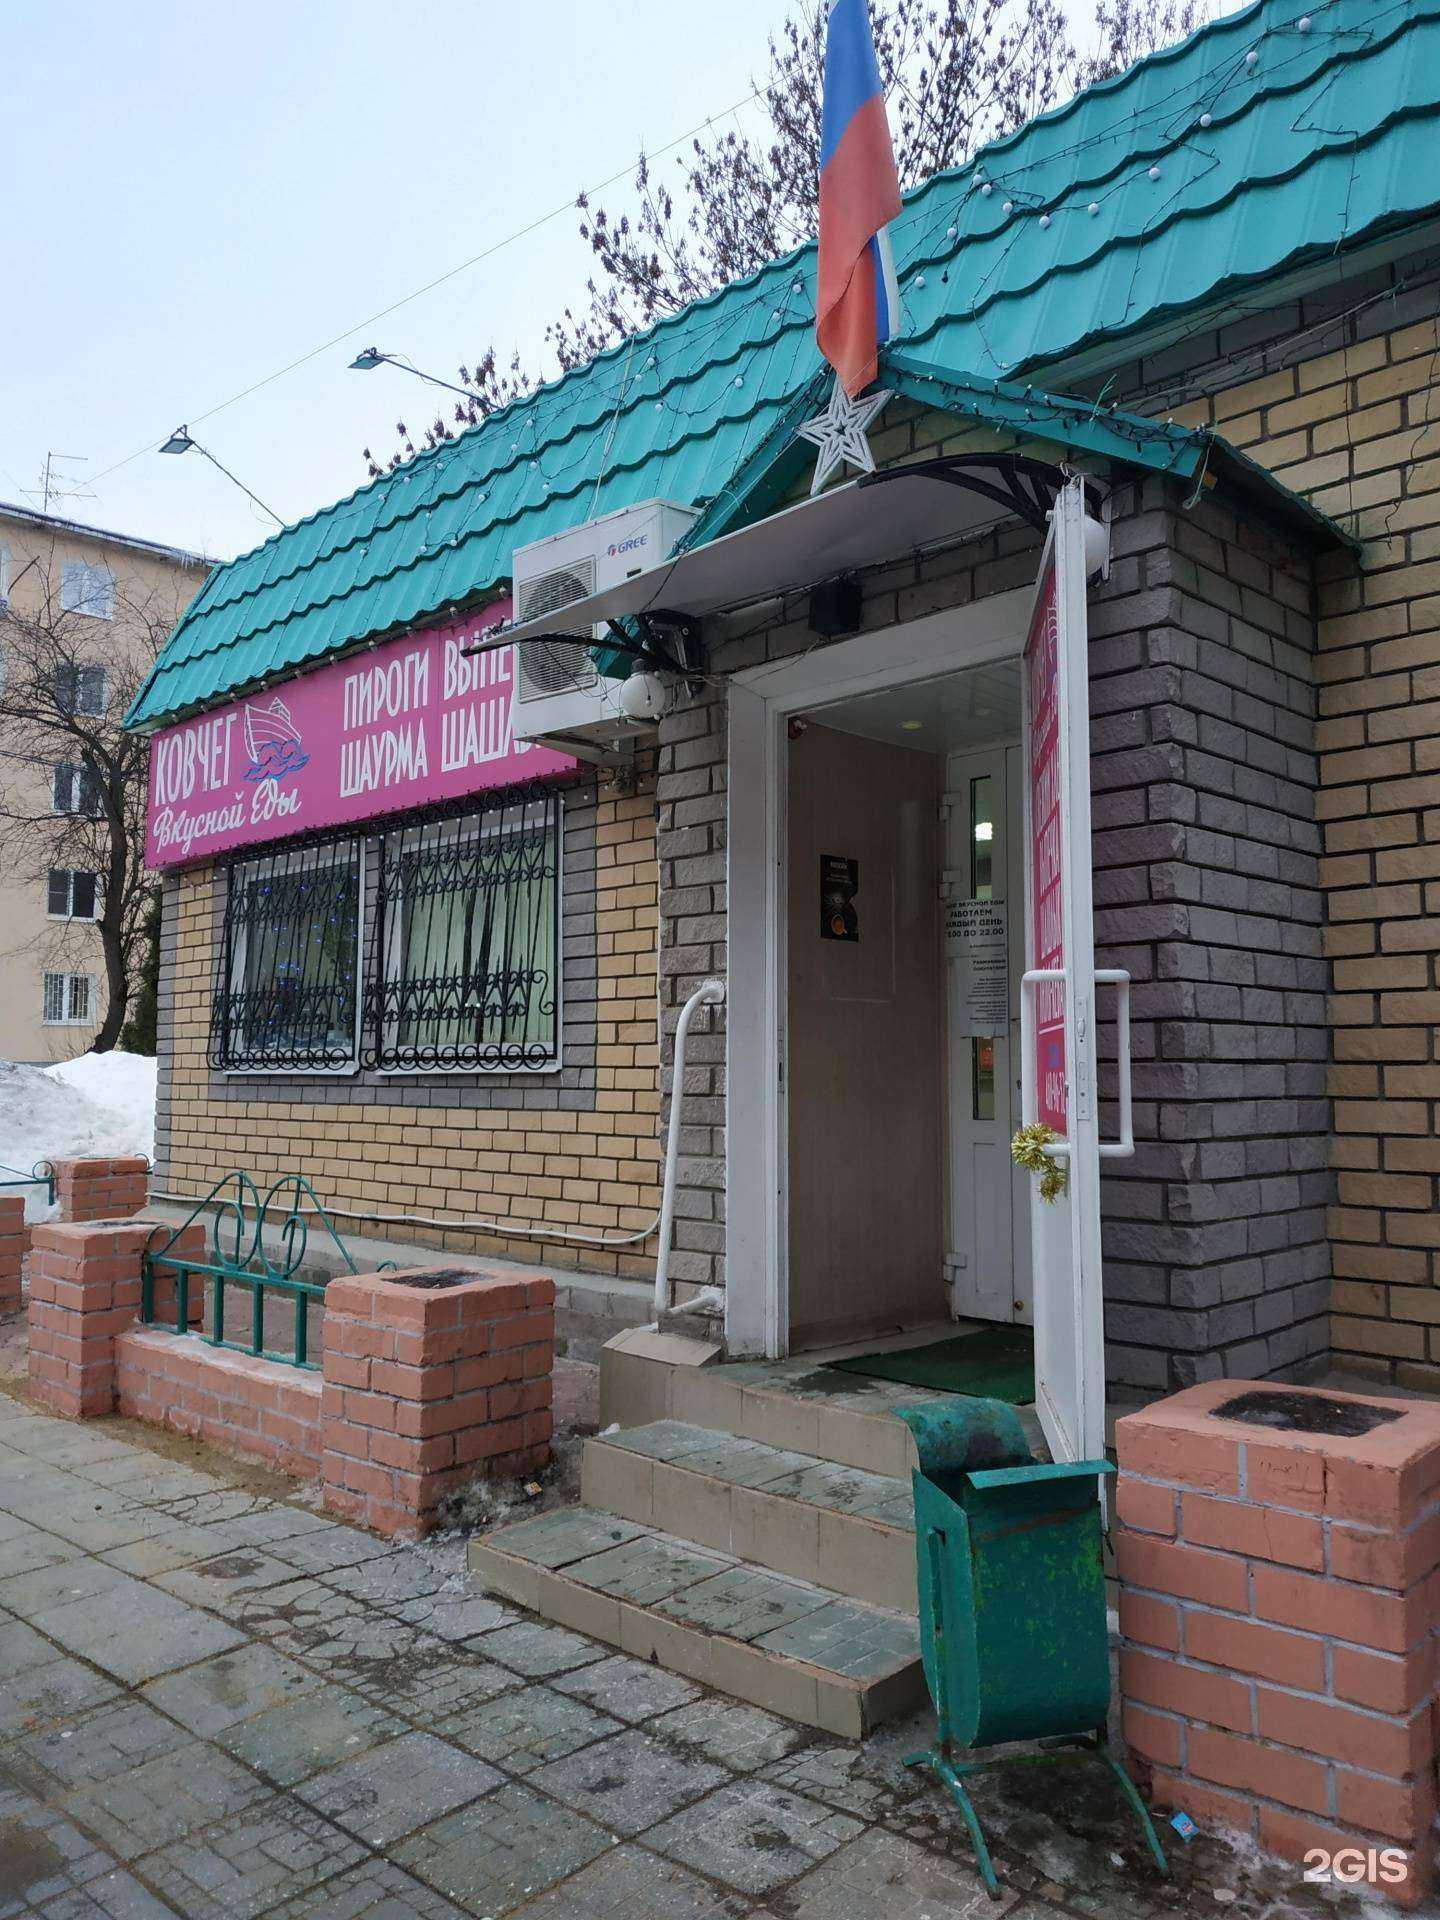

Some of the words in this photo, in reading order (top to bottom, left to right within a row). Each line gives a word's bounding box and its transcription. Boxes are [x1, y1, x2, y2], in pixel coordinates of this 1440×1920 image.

[617, 534, 648, 554] GREE
[343, 648, 430, 732] ПИРОГИ
[443, 618, 512, 700] ВЫПЕ
[155, 712, 238, 807] КОВЧЕГ
[340, 717, 429, 799] ШАУРМА
[153, 791, 247, 854] Вкусной
[250, 778, 302, 825] Еды
